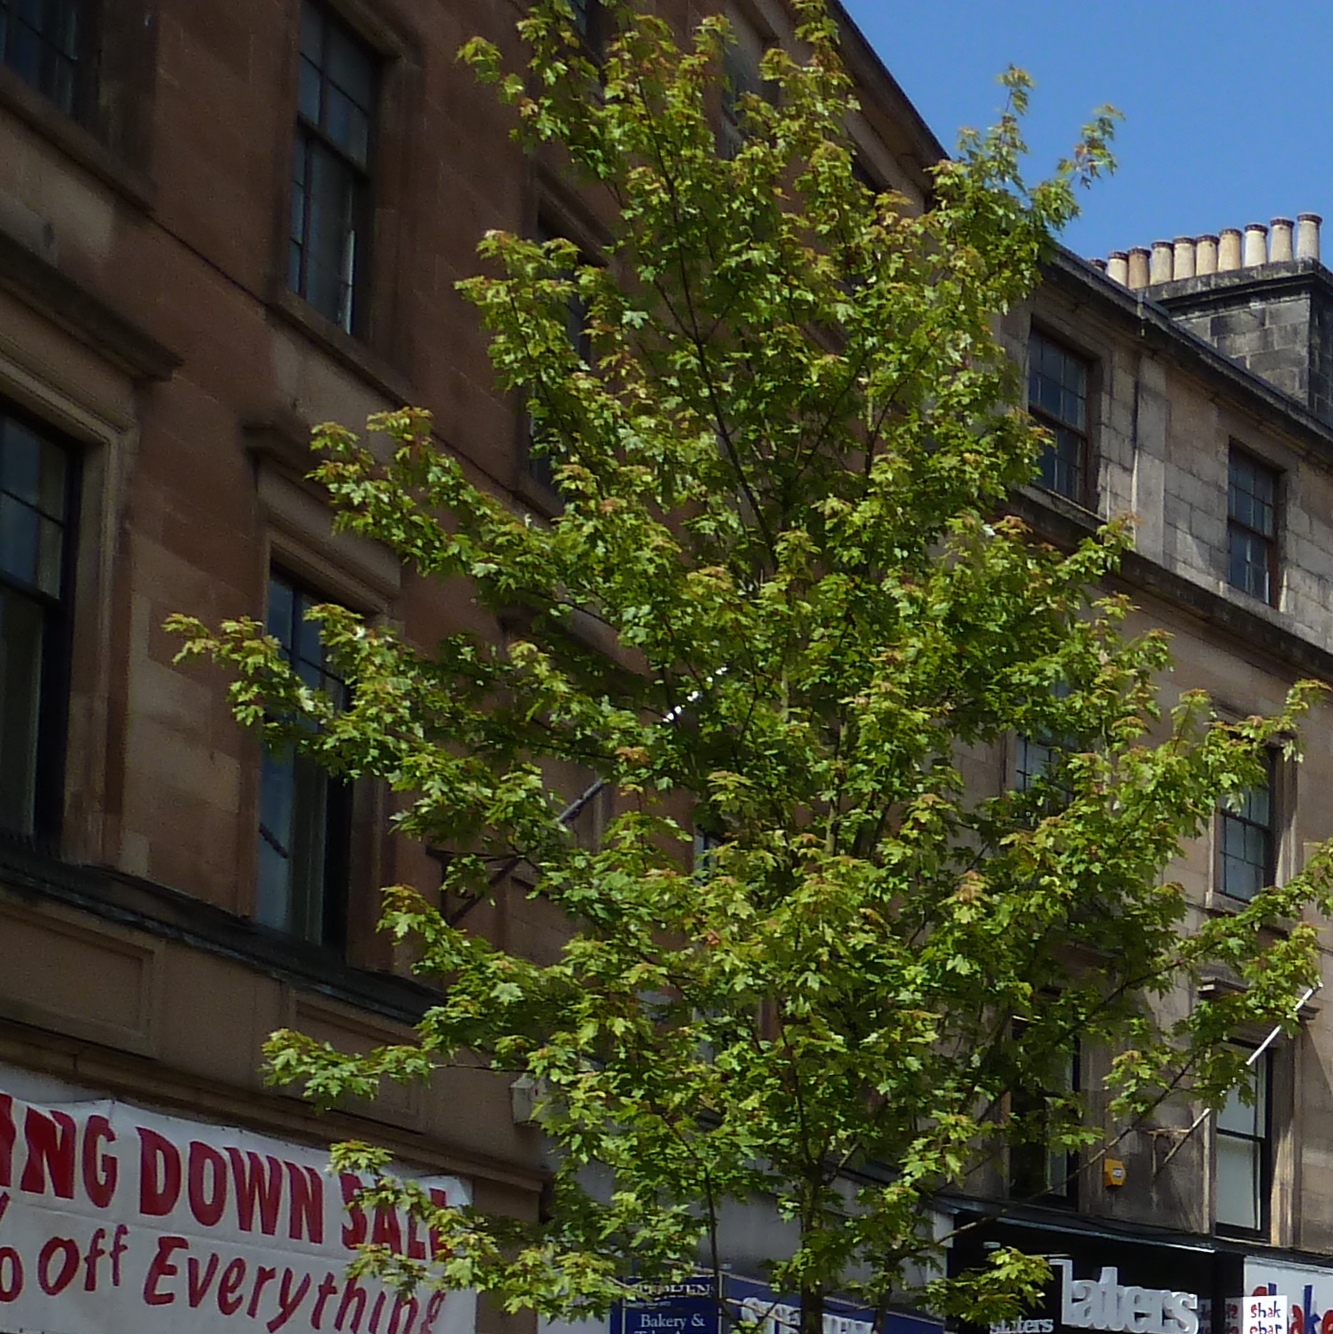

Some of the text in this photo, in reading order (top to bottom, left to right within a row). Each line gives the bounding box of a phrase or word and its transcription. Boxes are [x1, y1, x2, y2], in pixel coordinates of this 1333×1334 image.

[135, 1126, 324, 1244] DOWN
[1250, 1300, 1281, 1319] shak
[640, 1312, 706, 1330] Bakery &
